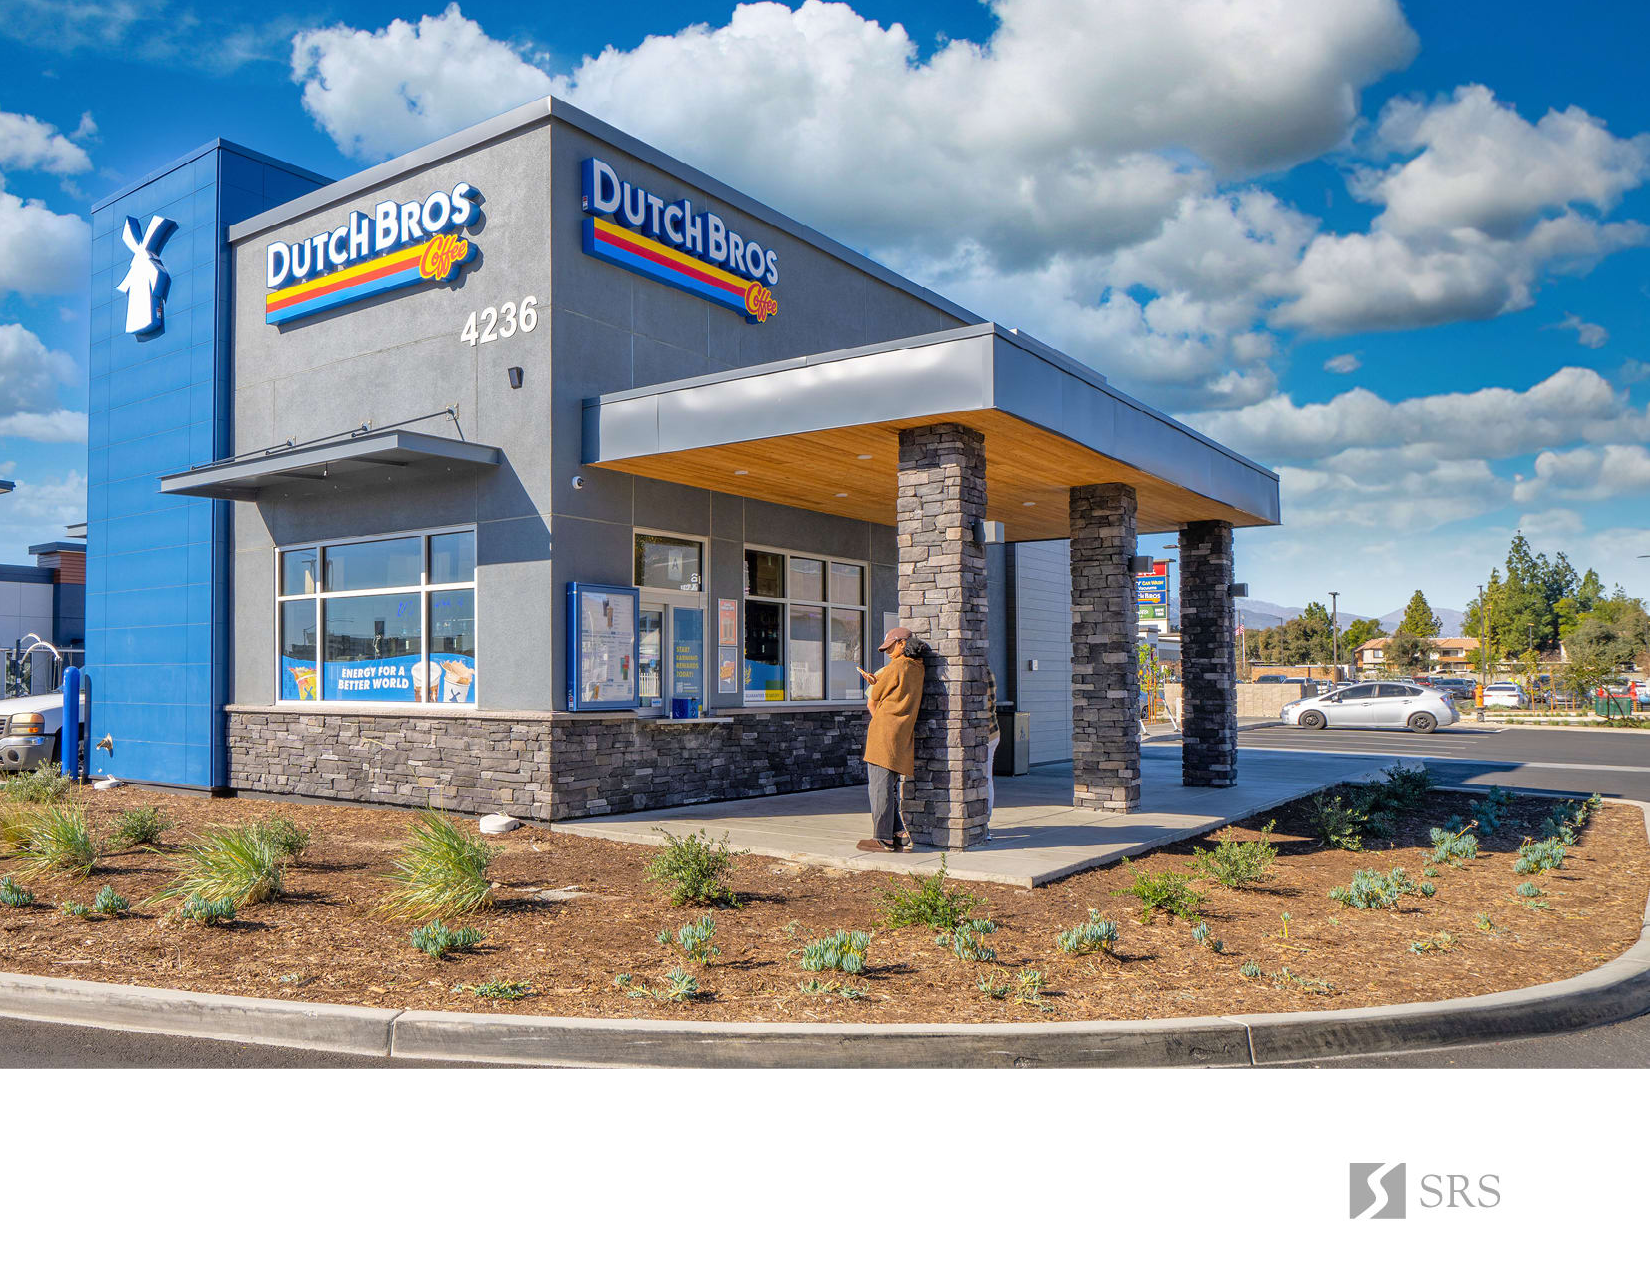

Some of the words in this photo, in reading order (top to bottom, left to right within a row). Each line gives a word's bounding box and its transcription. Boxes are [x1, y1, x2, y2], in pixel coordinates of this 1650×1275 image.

[375, 181, 471, 251] BROS
[420, 234, 467, 280] Coffee
[708, 212, 779, 285] BROS
[460, 295, 538, 347] 4236
[745, 281, 778, 323] Coffee
[672, 557, 679, 570] A
[338, 679, 370, 690] BETTER
[372, 677, 409, 689] WORLD
[341, 667, 376, 678] ENERGY
[378, 666, 396, 676] FOR
[398, 666, 405, 676] A
